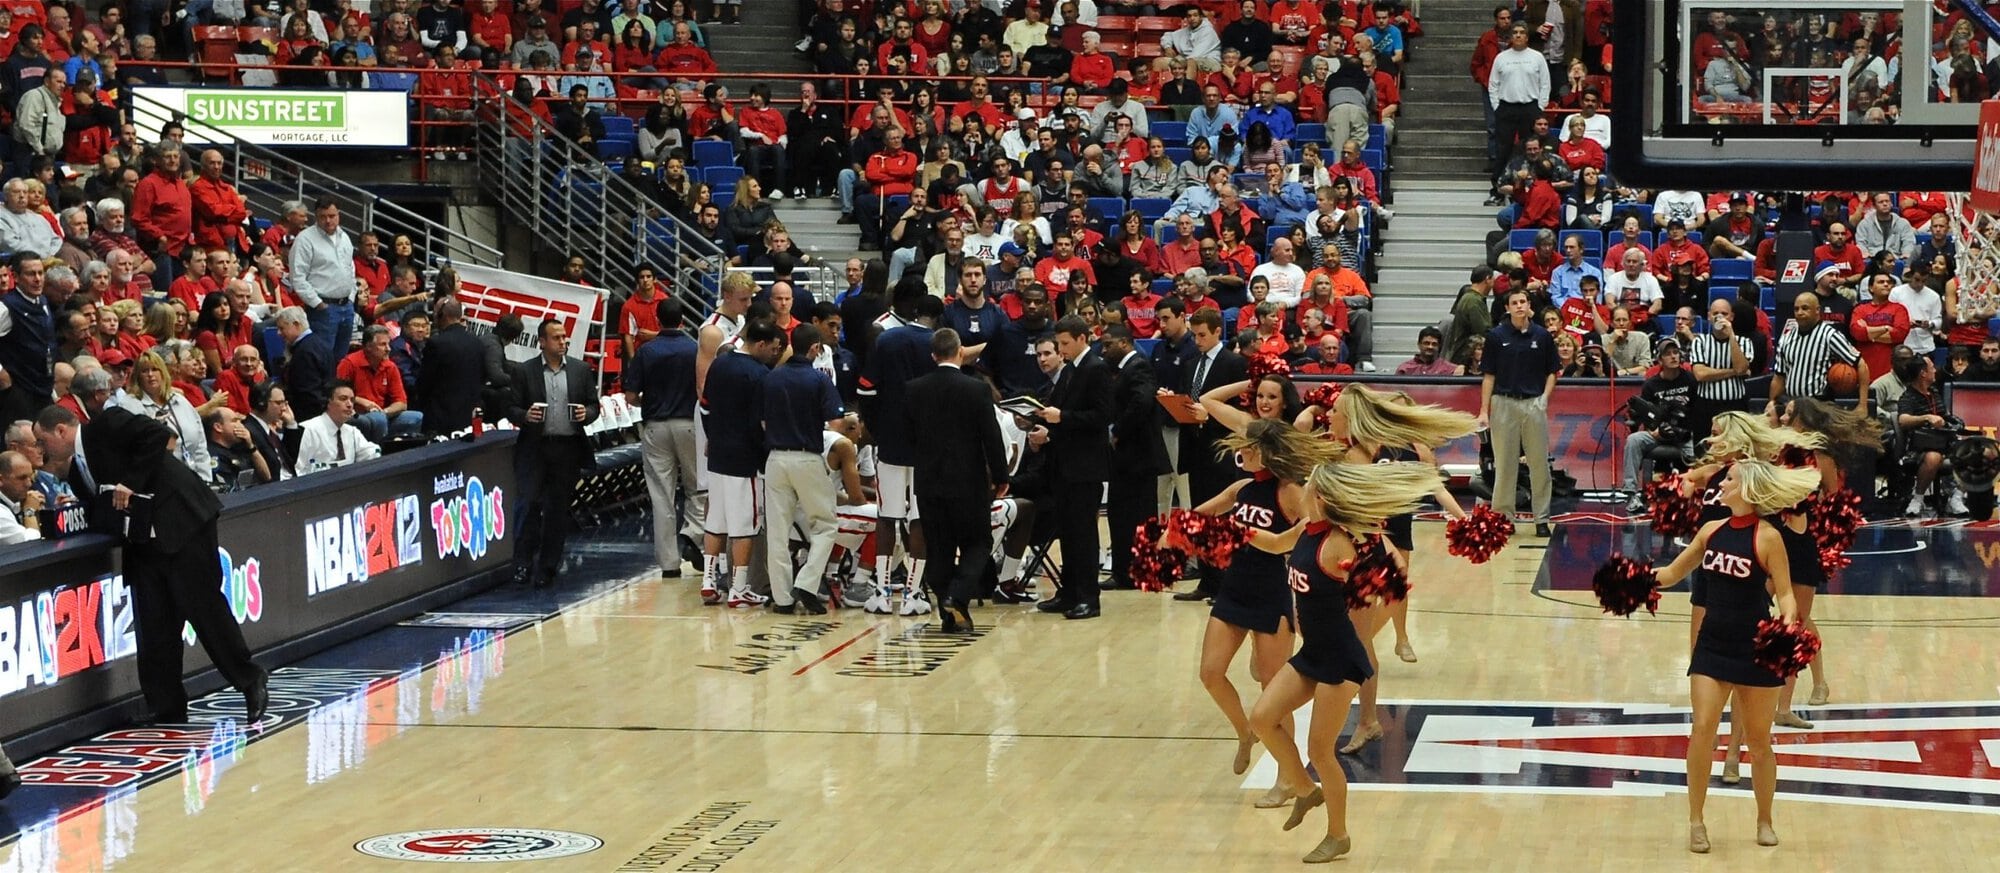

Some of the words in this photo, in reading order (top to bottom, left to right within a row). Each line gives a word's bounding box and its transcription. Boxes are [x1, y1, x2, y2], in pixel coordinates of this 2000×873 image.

[193, 99, 336, 122] SUNSTREET
[272, 132, 329, 143] MORTGAGE,
[331, 134, 349, 143] LLC
[455, 281, 580, 339] ESPN
[63, 507, 88, 533] POSS.
[1234, 502, 1273, 528] ATS
[305, 513, 358, 596] NBA
[1702, 549, 1752, 578] CATS
[709, 820, 782, 846] CENTER
[675, 846, 745, 873] EDICAL
